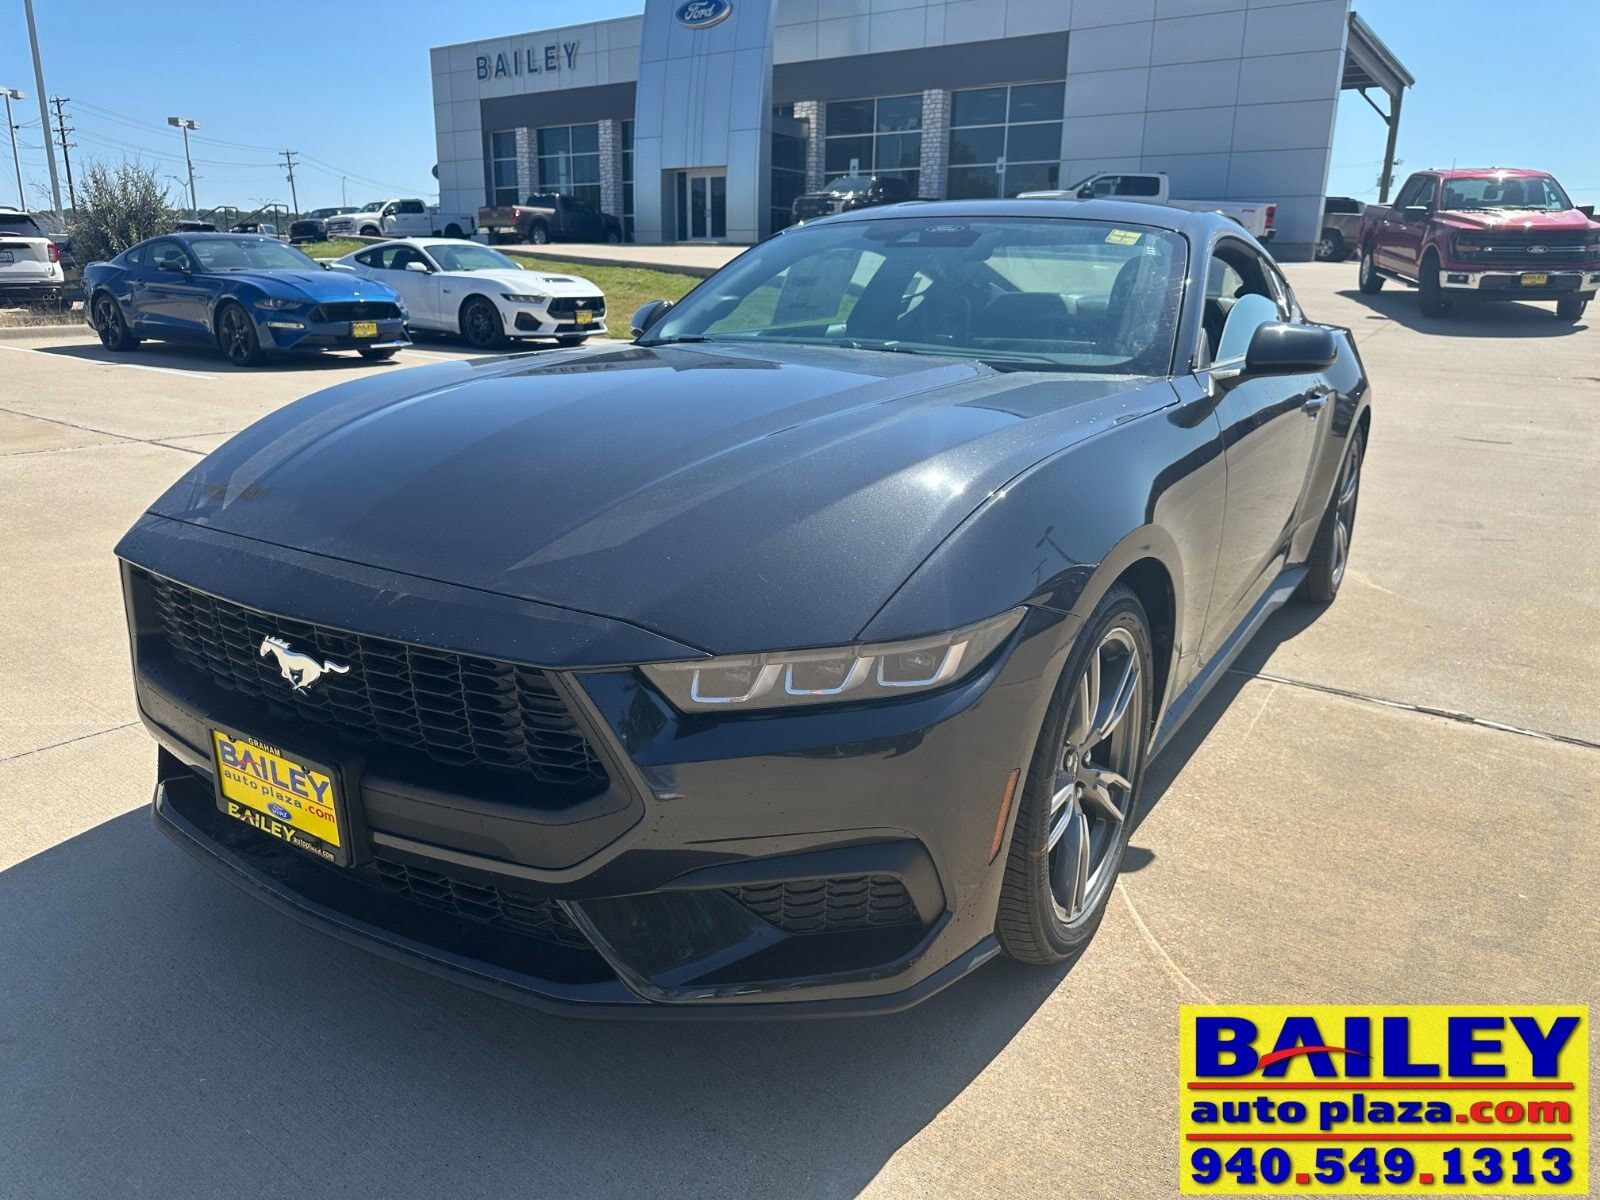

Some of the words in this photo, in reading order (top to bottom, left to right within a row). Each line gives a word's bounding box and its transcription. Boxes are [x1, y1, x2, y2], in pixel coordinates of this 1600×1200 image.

[684, 1, 716, 20] Ford
[476, 42, 578, 80] BAILEY
[248, 737, 281, 757] GRAHAM
[218, 740, 330, 803] BAILEY
[224, 769, 258, 789] auto
[270, 805, 289, 819] Ford
[227, 802, 296, 843] BAILEY
